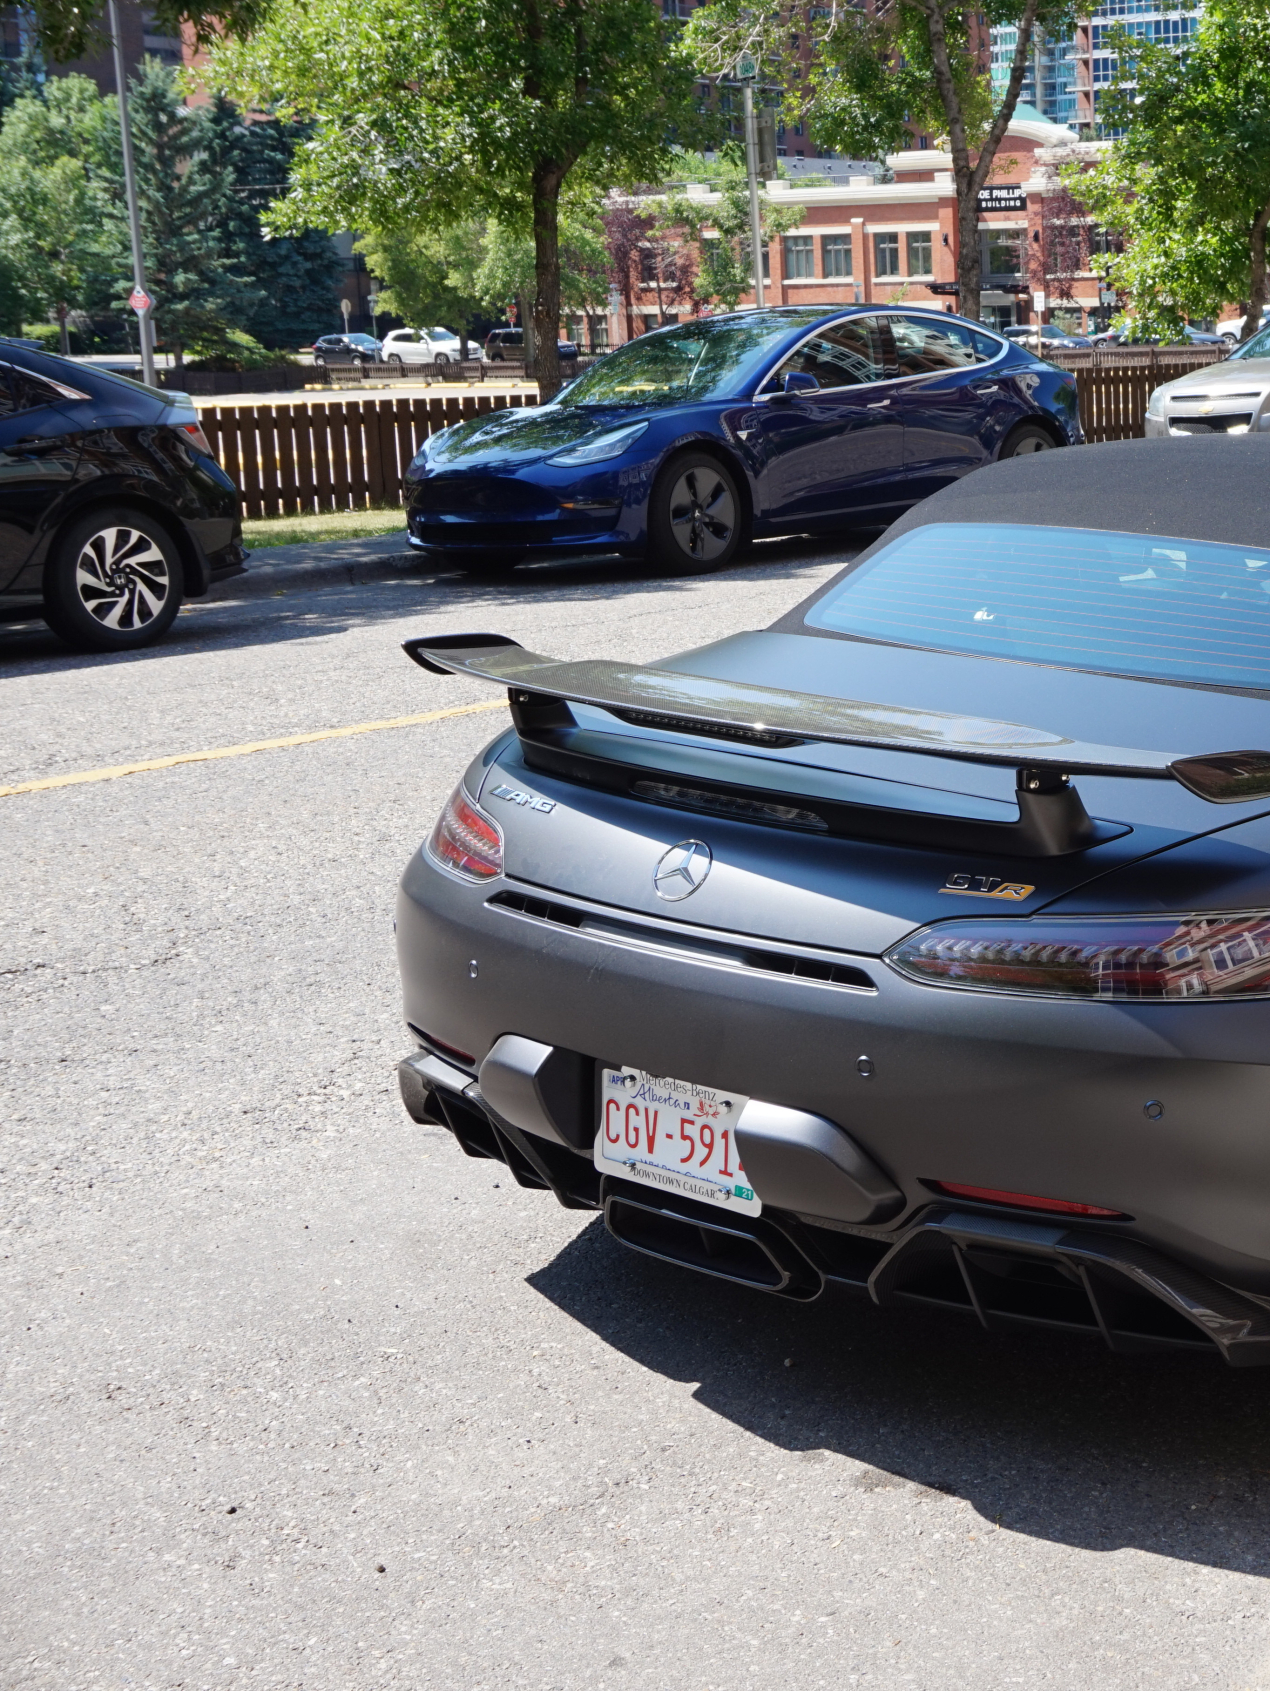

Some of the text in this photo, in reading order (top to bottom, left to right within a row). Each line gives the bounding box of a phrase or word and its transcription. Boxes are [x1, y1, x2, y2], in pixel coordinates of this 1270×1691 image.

[982, 200, 1021, 208] BUILDING
[993, 189, 1027, 199] PHILLIPS
[498, 788, 556, 814] AMG
[630, 1083, 685, 1110] Alberta
[638, 1070, 716, 1103] Mercedes-Benz
[605, 1099, 748, 1178] CGV-591
[633, 1167, 681, 1189] DOWNTOWN
[742, 1189, 752, 1199] 21
